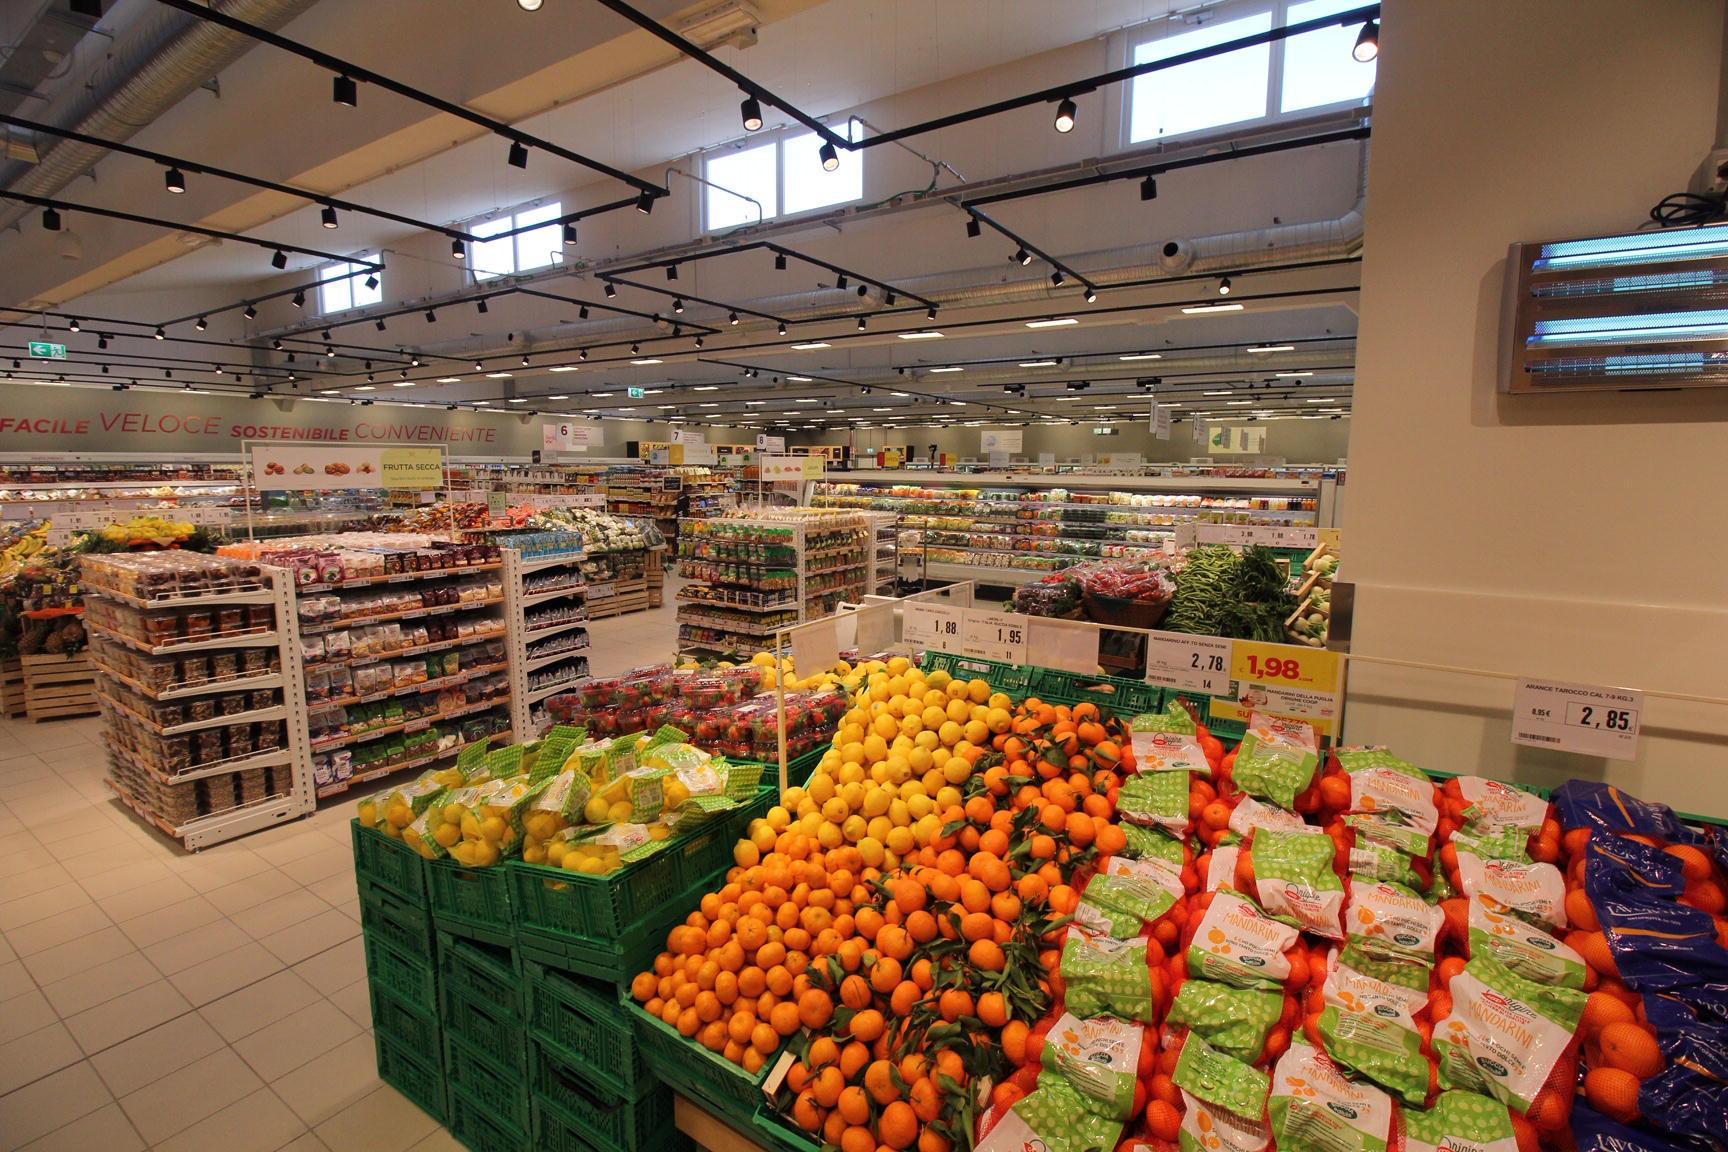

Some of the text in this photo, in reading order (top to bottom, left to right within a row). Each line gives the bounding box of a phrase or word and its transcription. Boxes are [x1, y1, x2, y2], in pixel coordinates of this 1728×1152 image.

[0, 412, 497, 443] FACILE VELOCE SOSTENIBILE CONVENIENTE
[560, 425, 568, 436] 6
[673, 431, 679, 441] 7
[759, 435, 764, 444] 8
[383, 463, 441, 471] FRUTTA SECCA
[935, 620, 957, 635] 1,88
[998, 628, 1021, 645] 1,95
[1191, 652, 1223, 671] 2,78
[1247, 655, 1300, 680] 1,98
[1203, 679, 1211, 688] 14
[1525, 683, 1553, 692] ARANCE
[1555, 687, 1589, 696] TAROCCO
[1589, 691, 1604, 699] CAL
[1296, 692, 1314, 700] DELLA
[1580, 706, 1629, 731] 2,85
[1223, 911, 1280, 941] MANDARINI
